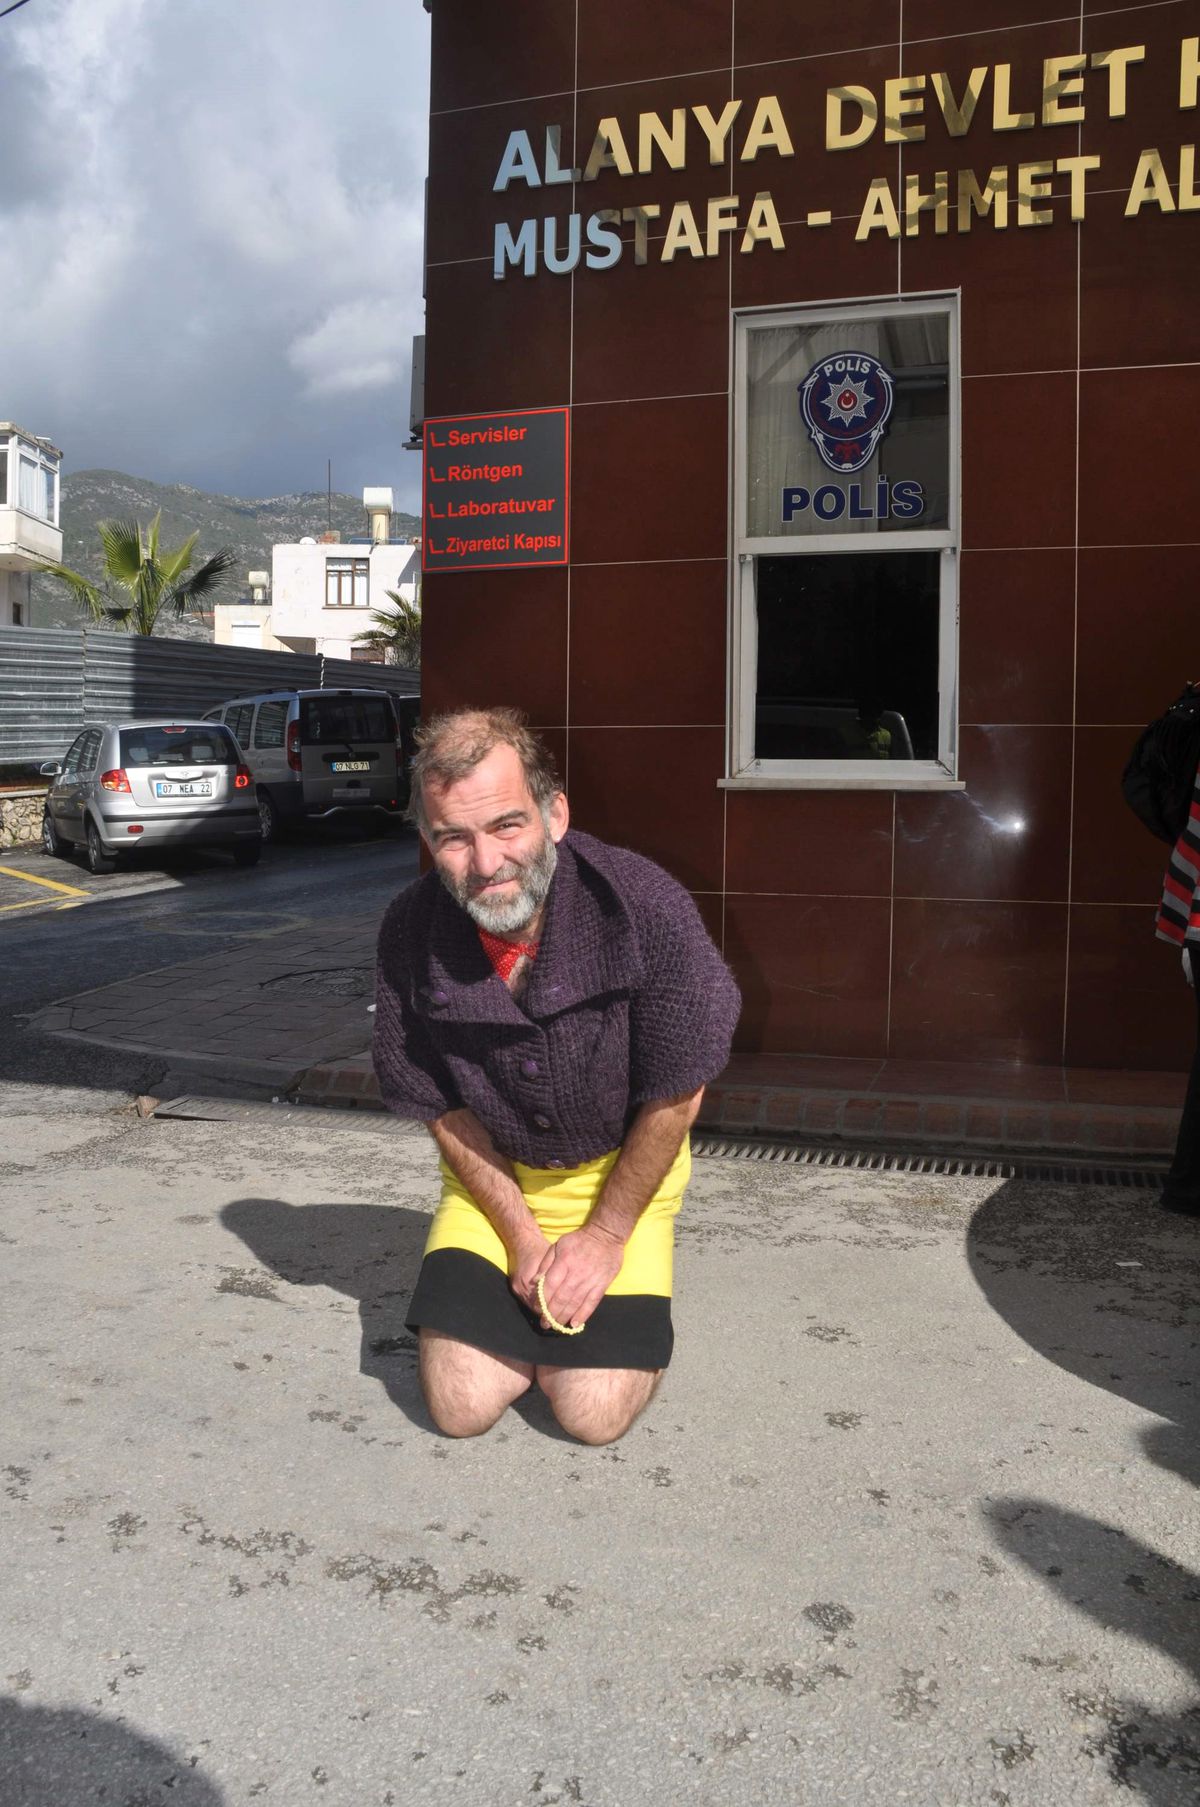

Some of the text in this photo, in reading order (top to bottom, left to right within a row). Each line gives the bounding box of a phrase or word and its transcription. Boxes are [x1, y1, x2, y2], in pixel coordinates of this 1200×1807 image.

[493, 96, 795, 192] ALANYA
[826, 45, 1146, 151] DEVLET
[494, 191, 785, 280] MUSTAFA
[807, 211, 832, 228] -
[855, 155, 1100, 242] AHMET
[823, 357, 872, 377] POLİS
[448, 425, 528, 446] Servisler
[447, 463, 523, 483] Röntgen
[447, 498, 556, 517] Laboratuvar
[781, 474, 924, 523] POLİS
[446, 533, 562, 556] Ziyaretci Kapısı
[162, 784, 210, 794] 07 NEA 22
